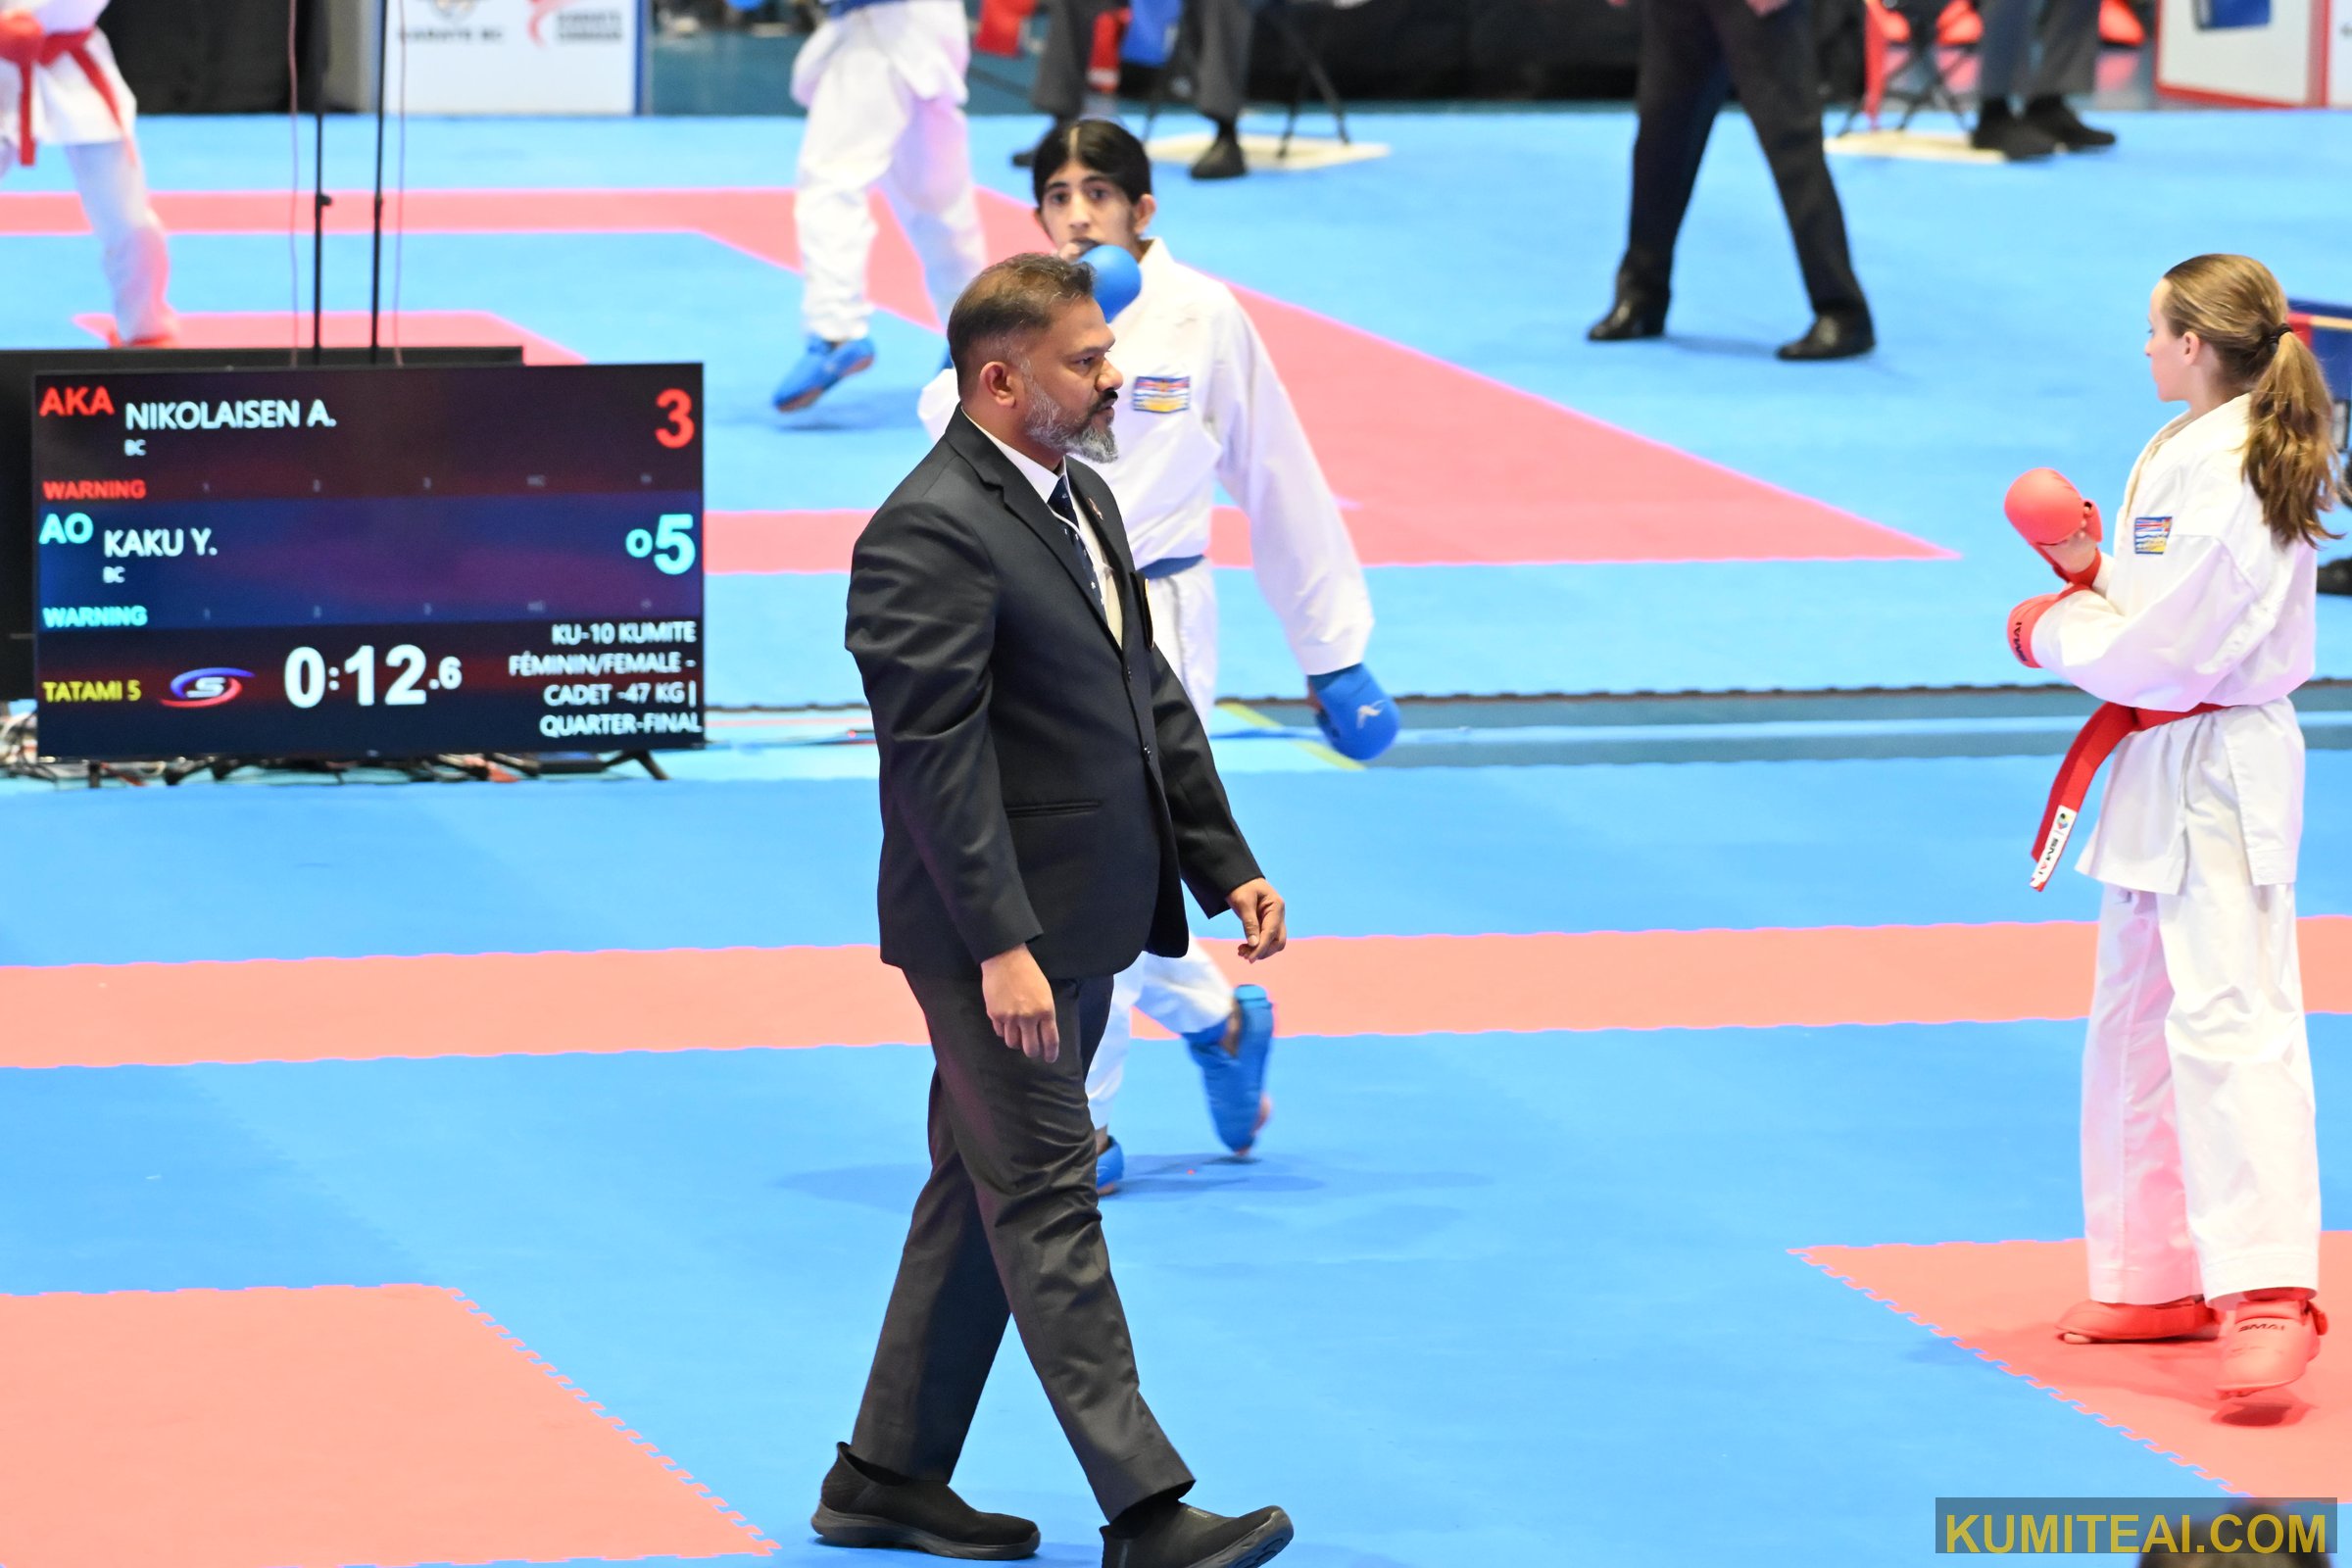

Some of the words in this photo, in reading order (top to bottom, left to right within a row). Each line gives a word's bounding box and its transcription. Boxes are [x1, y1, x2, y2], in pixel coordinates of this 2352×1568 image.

[39, 386, 115, 416] AKA
[124, 400, 300, 429] NIKOLAISEN
[307, 399, 337, 426] A.
[656, 388, 695, 449] 3
[43, 479, 146, 499] WARNING
[39, 513, 94, 544] AO
[104, 529, 184, 557] KAKU
[190, 527, 218, 556] Y.
[42, 607, 147, 627] WARNING
[552, 622, 615, 645] KU-10
[618, 620, 697, 643] KUMITE
[509, 650, 681, 676] FÉMININ/FEMALE
[42, 681, 122, 703] TATAMI
[127, 679, 142, 701] 5
[543, 683, 612, 707] CADET
[616, 681, 652, 705] -47
[656, 681, 685, 704] KG
[539, 712, 703, 738] QUARTER-FINAL
